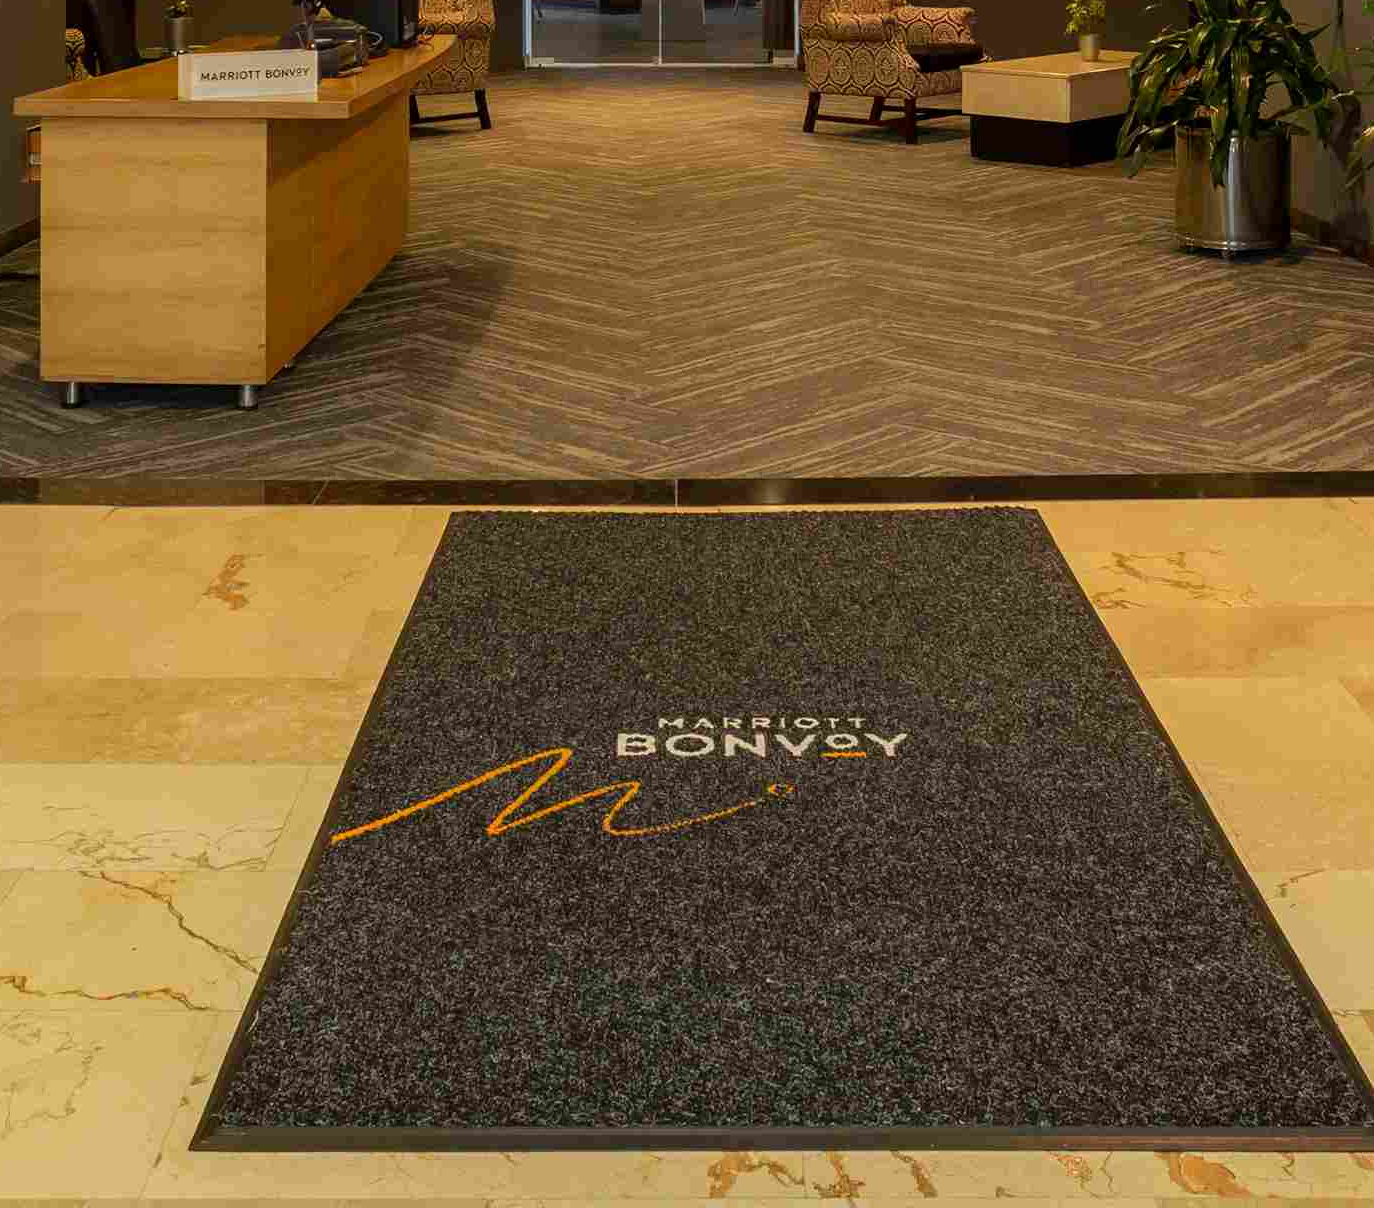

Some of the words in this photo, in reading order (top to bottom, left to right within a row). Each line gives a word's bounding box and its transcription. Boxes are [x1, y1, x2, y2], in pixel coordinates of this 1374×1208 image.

[201, 70, 261, 81] MARRIOTT
[658, 716, 867, 729] MARRIOTT
[616, 732, 908, 758] BONVOY
